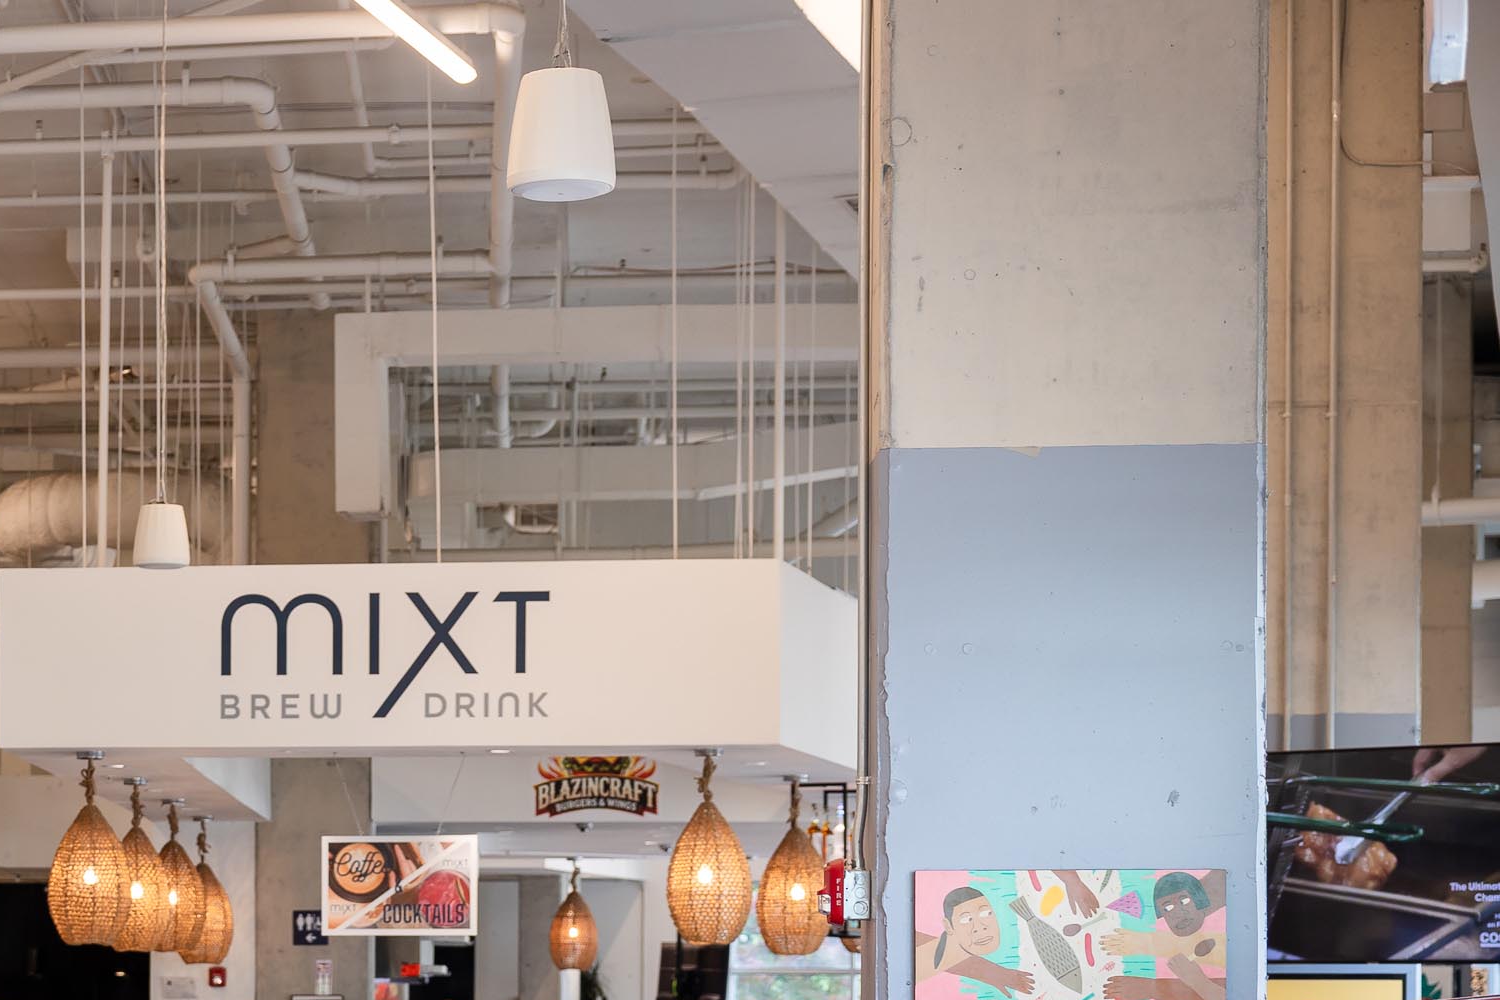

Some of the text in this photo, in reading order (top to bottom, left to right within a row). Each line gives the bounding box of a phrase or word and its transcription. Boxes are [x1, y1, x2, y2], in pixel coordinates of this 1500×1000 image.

[220, 692, 549, 719] BREW DRINK
[537, 776, 657, 810] BLAZINCRAFT
[607, 799, 638, 811] WINGS
[835, 878, 843, 906] FIRE
[1449, 882, 1467, 891] The
[383, 903, 465, 924] COCKTAILS
